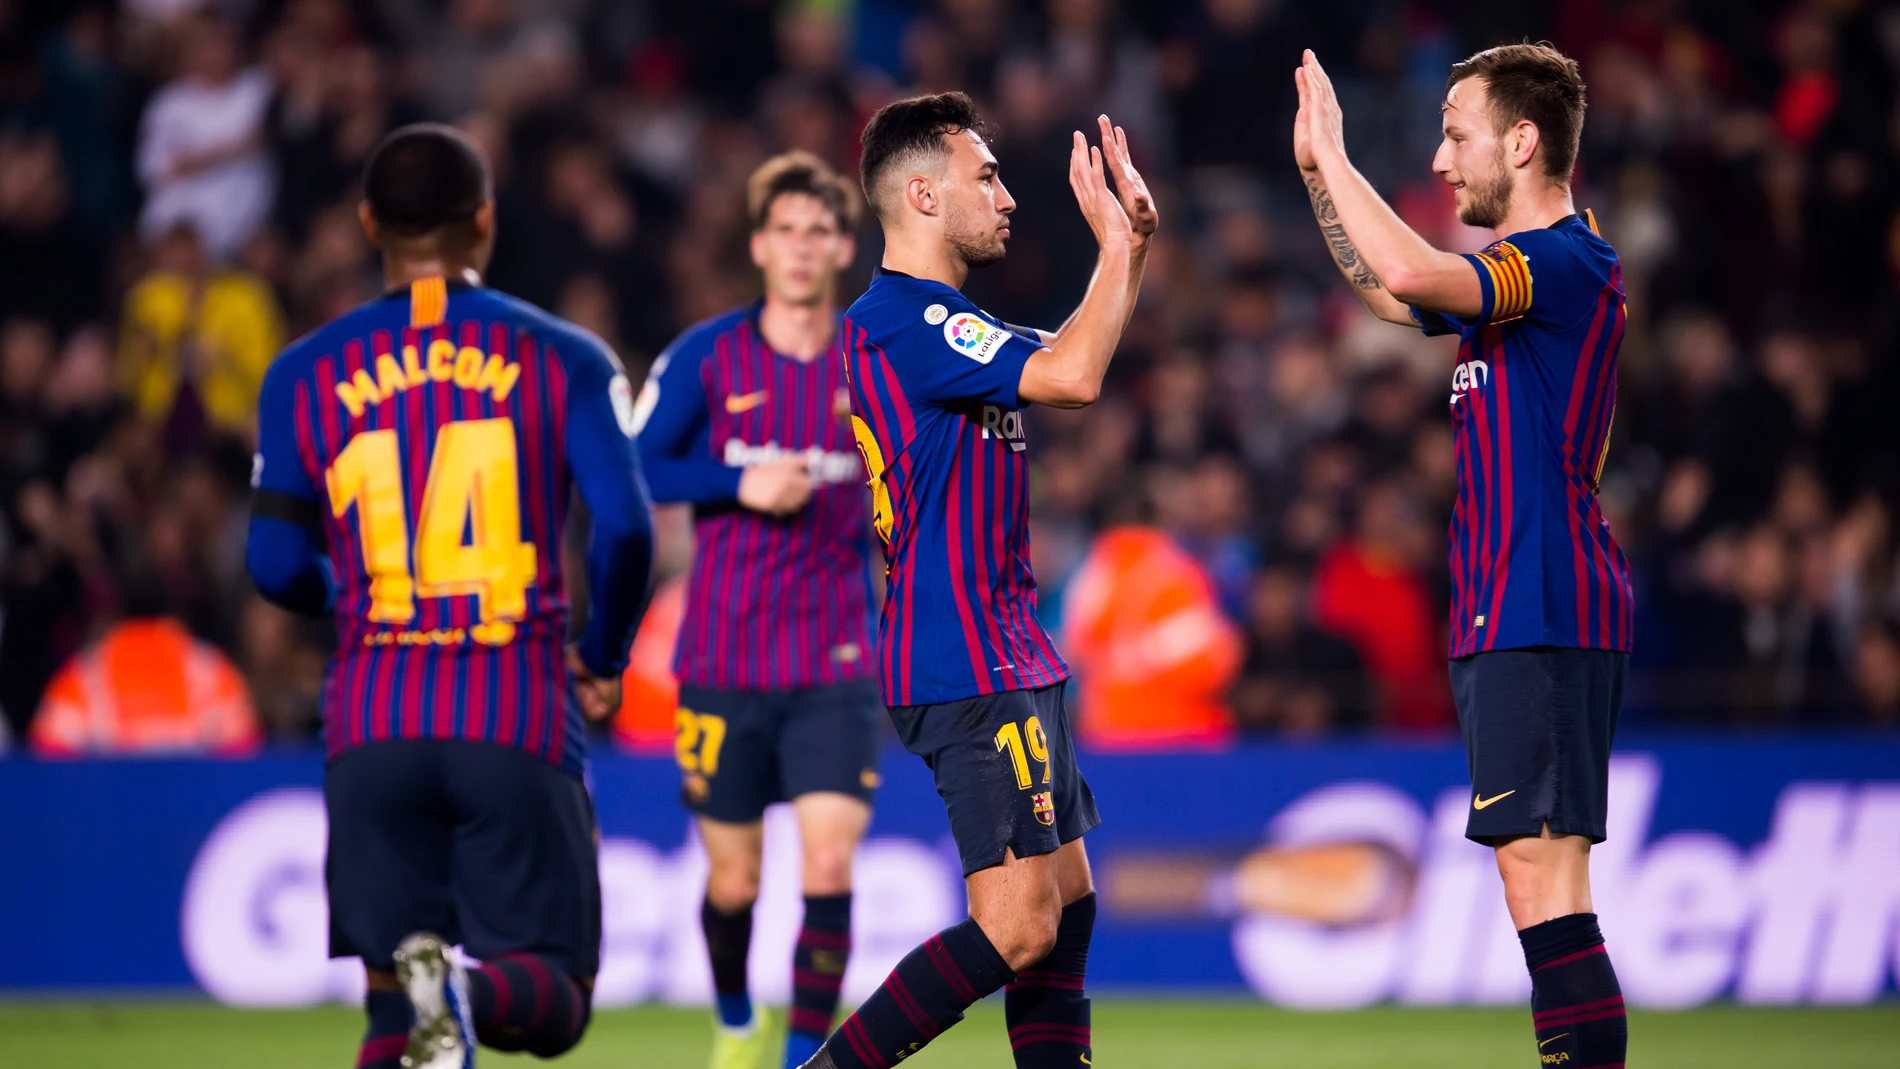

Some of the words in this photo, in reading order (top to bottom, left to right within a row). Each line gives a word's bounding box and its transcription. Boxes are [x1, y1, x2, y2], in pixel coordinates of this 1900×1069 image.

[335, 339, 520, 417] MALCOM
[978, 330, 1002, 357] LaLiga
[325, 417, 536, 624] 14
[674, 707, 727, 777] 27
[994, 716, 1050, 790] 19
[1540, 1052, 1570, 1065] ARÇA
